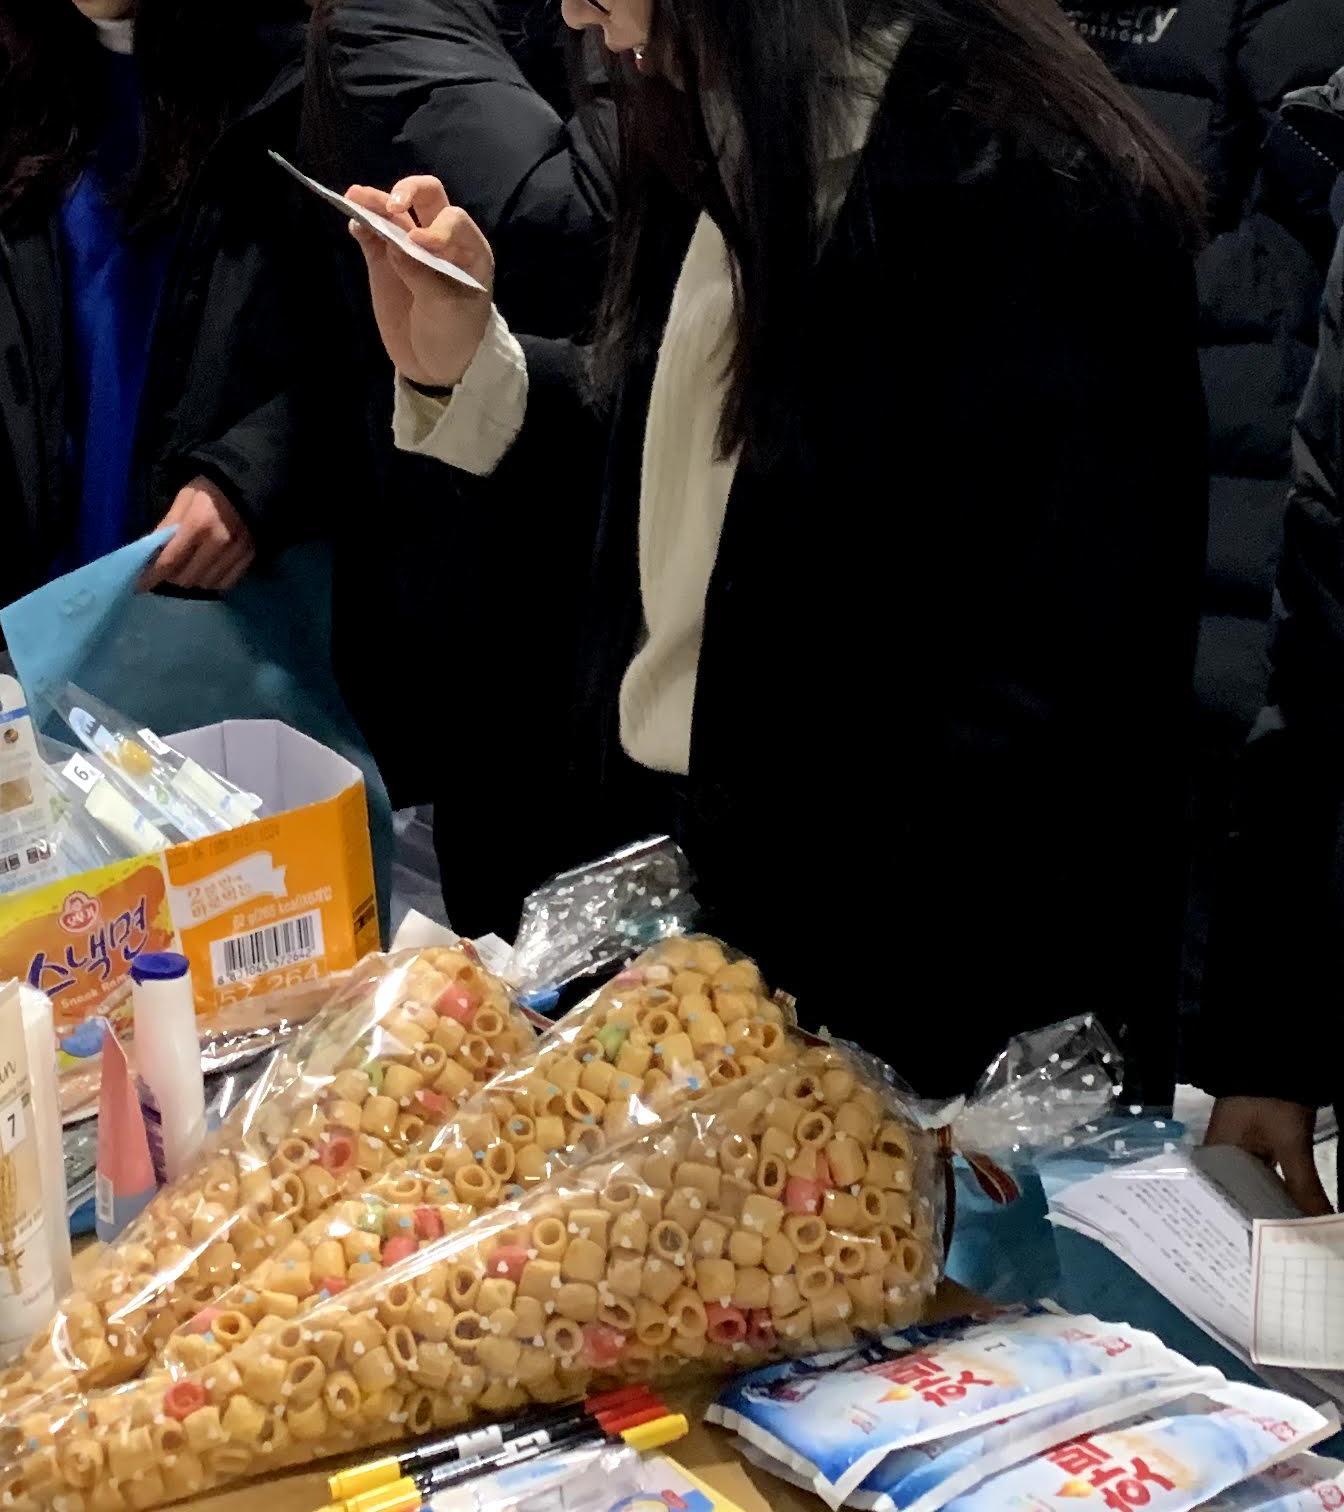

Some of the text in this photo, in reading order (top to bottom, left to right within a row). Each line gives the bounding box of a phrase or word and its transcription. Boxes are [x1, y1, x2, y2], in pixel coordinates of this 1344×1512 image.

[29, 898, 149, 996] 스낵면
[60, 974, 129, 1009] Snack Ram
[6, 1112, 16, 1138] 7
